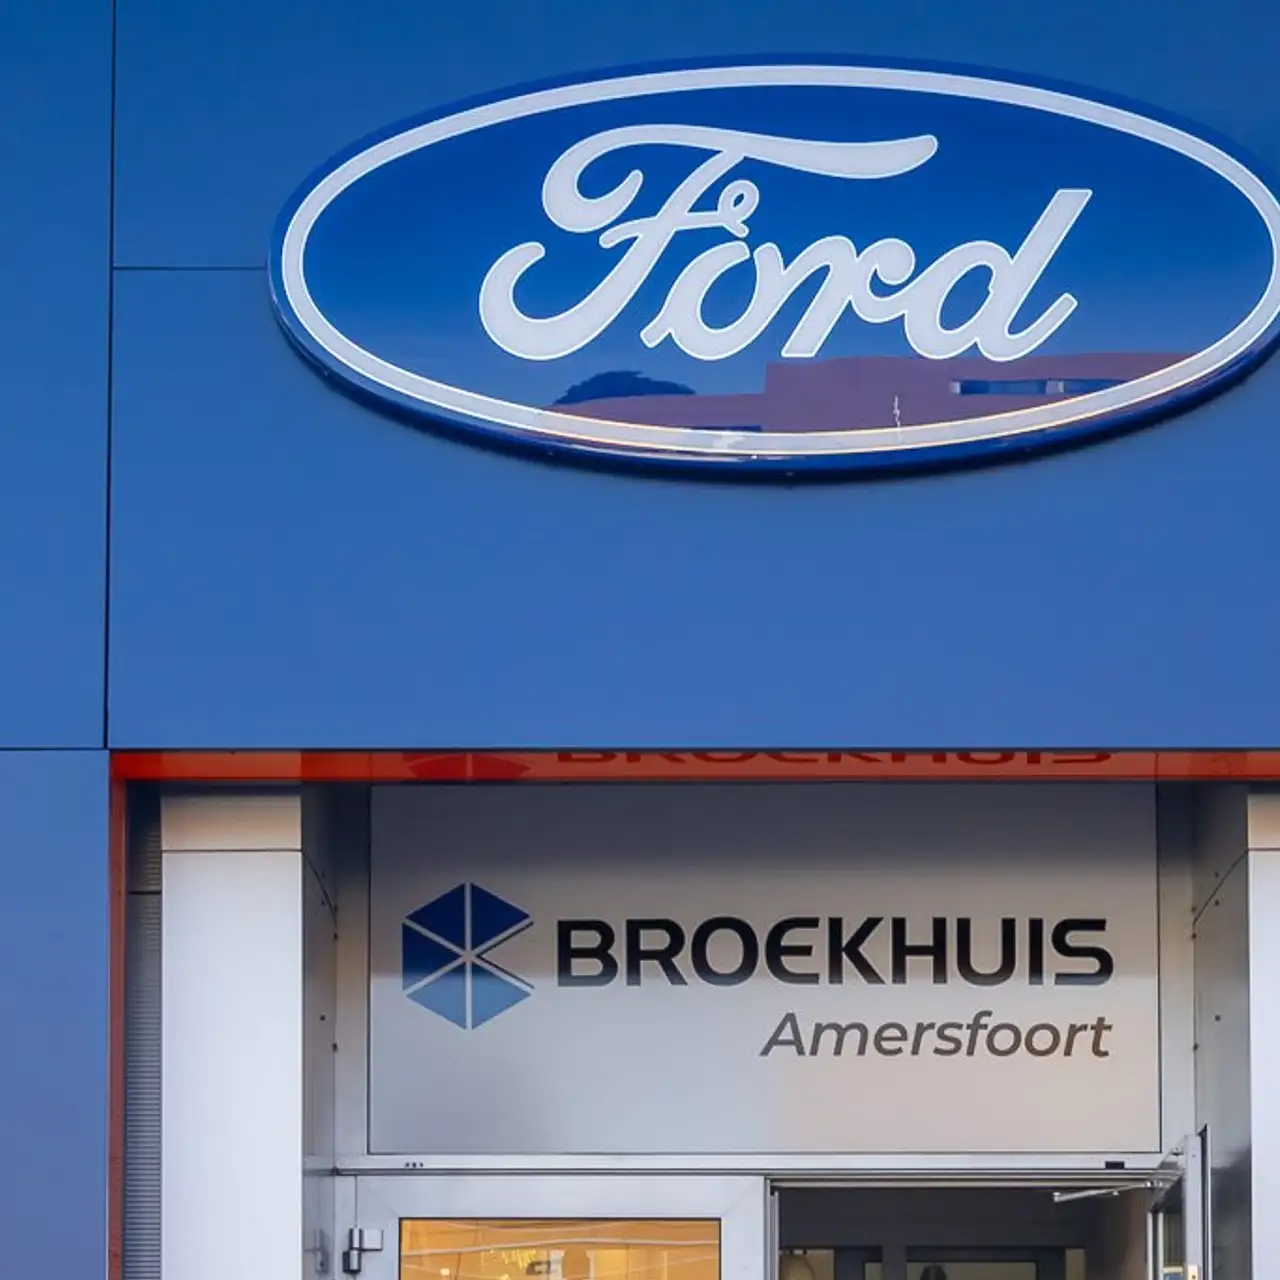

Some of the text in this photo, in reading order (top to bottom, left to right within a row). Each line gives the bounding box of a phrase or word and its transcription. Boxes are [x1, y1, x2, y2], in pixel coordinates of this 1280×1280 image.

[480, 124, 1092, 362] Ford
[556, 916, 1114, 986] BROEKHUIS
[761, 1010, 1113, 1057] Amersfoort
